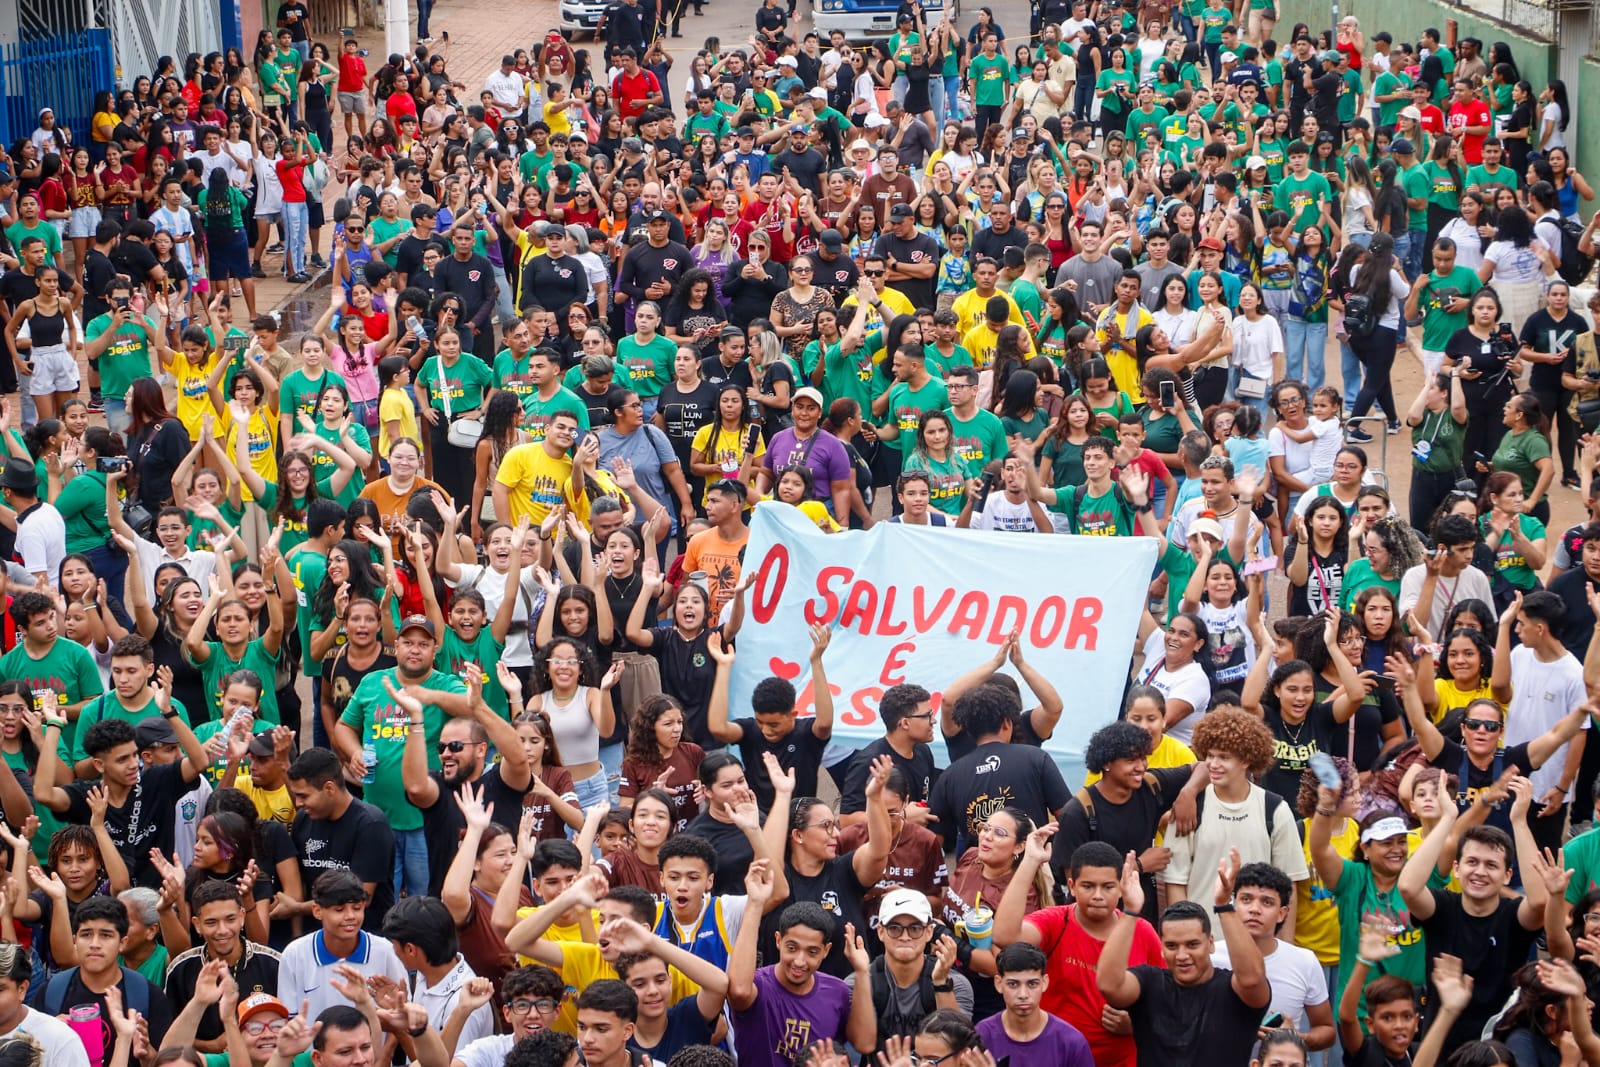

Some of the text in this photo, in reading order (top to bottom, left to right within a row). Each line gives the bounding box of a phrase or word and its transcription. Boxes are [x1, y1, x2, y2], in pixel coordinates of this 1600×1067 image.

[107, 342, 142, 356] Jesus
[629, 369, 656, 380] esus
[431, 389, 465, 400] Jeus
[683, 412, 703, 420] LUN
[930, 486, 964, 500] Jesu
[752, 543, 1104, 652] O SALVADOR
[879, 634, 917, 686] É
[371, 724, 409, 740] Jes
[127, 800, 142, 844] adidas
[889, 866, 914, 877] DE SE
[1383, 927, 1422, 947] sus
